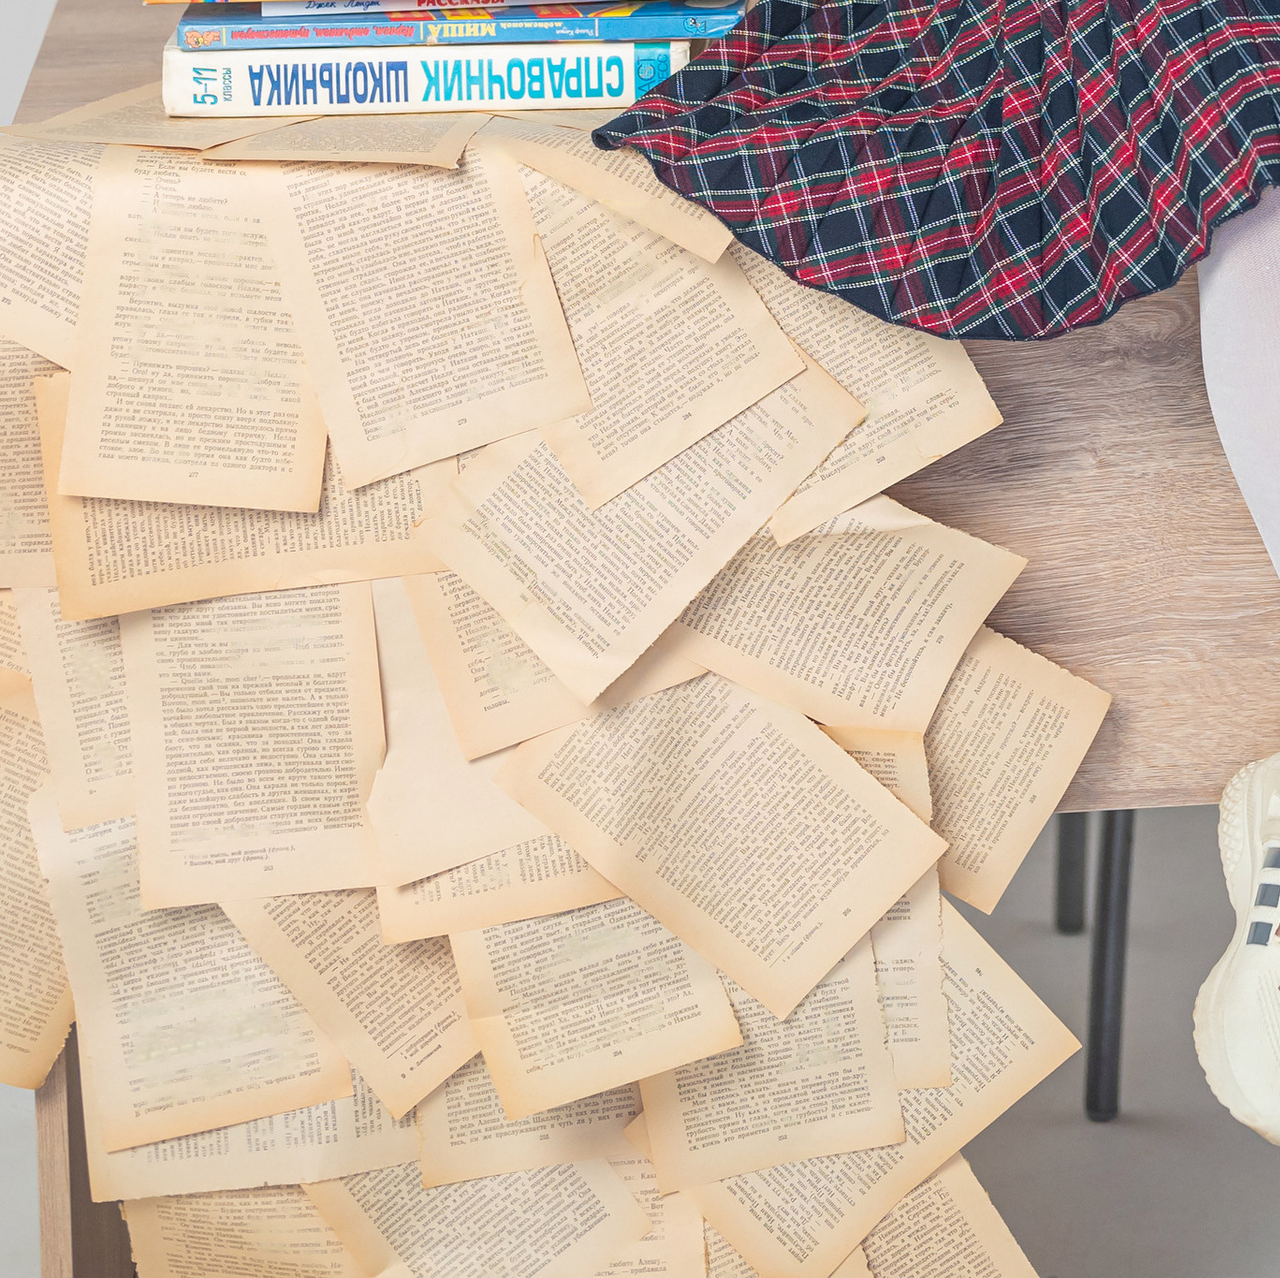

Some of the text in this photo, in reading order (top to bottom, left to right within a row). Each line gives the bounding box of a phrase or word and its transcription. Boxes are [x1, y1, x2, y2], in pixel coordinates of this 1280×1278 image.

[305, 0, 336, 9] Джек
[427, 21, 497, 38] МИША
[221, 67, 233, 102] классы
[247, 56, 625, 106] СПРАВОЧНИК ШКОЛЬНИКА
